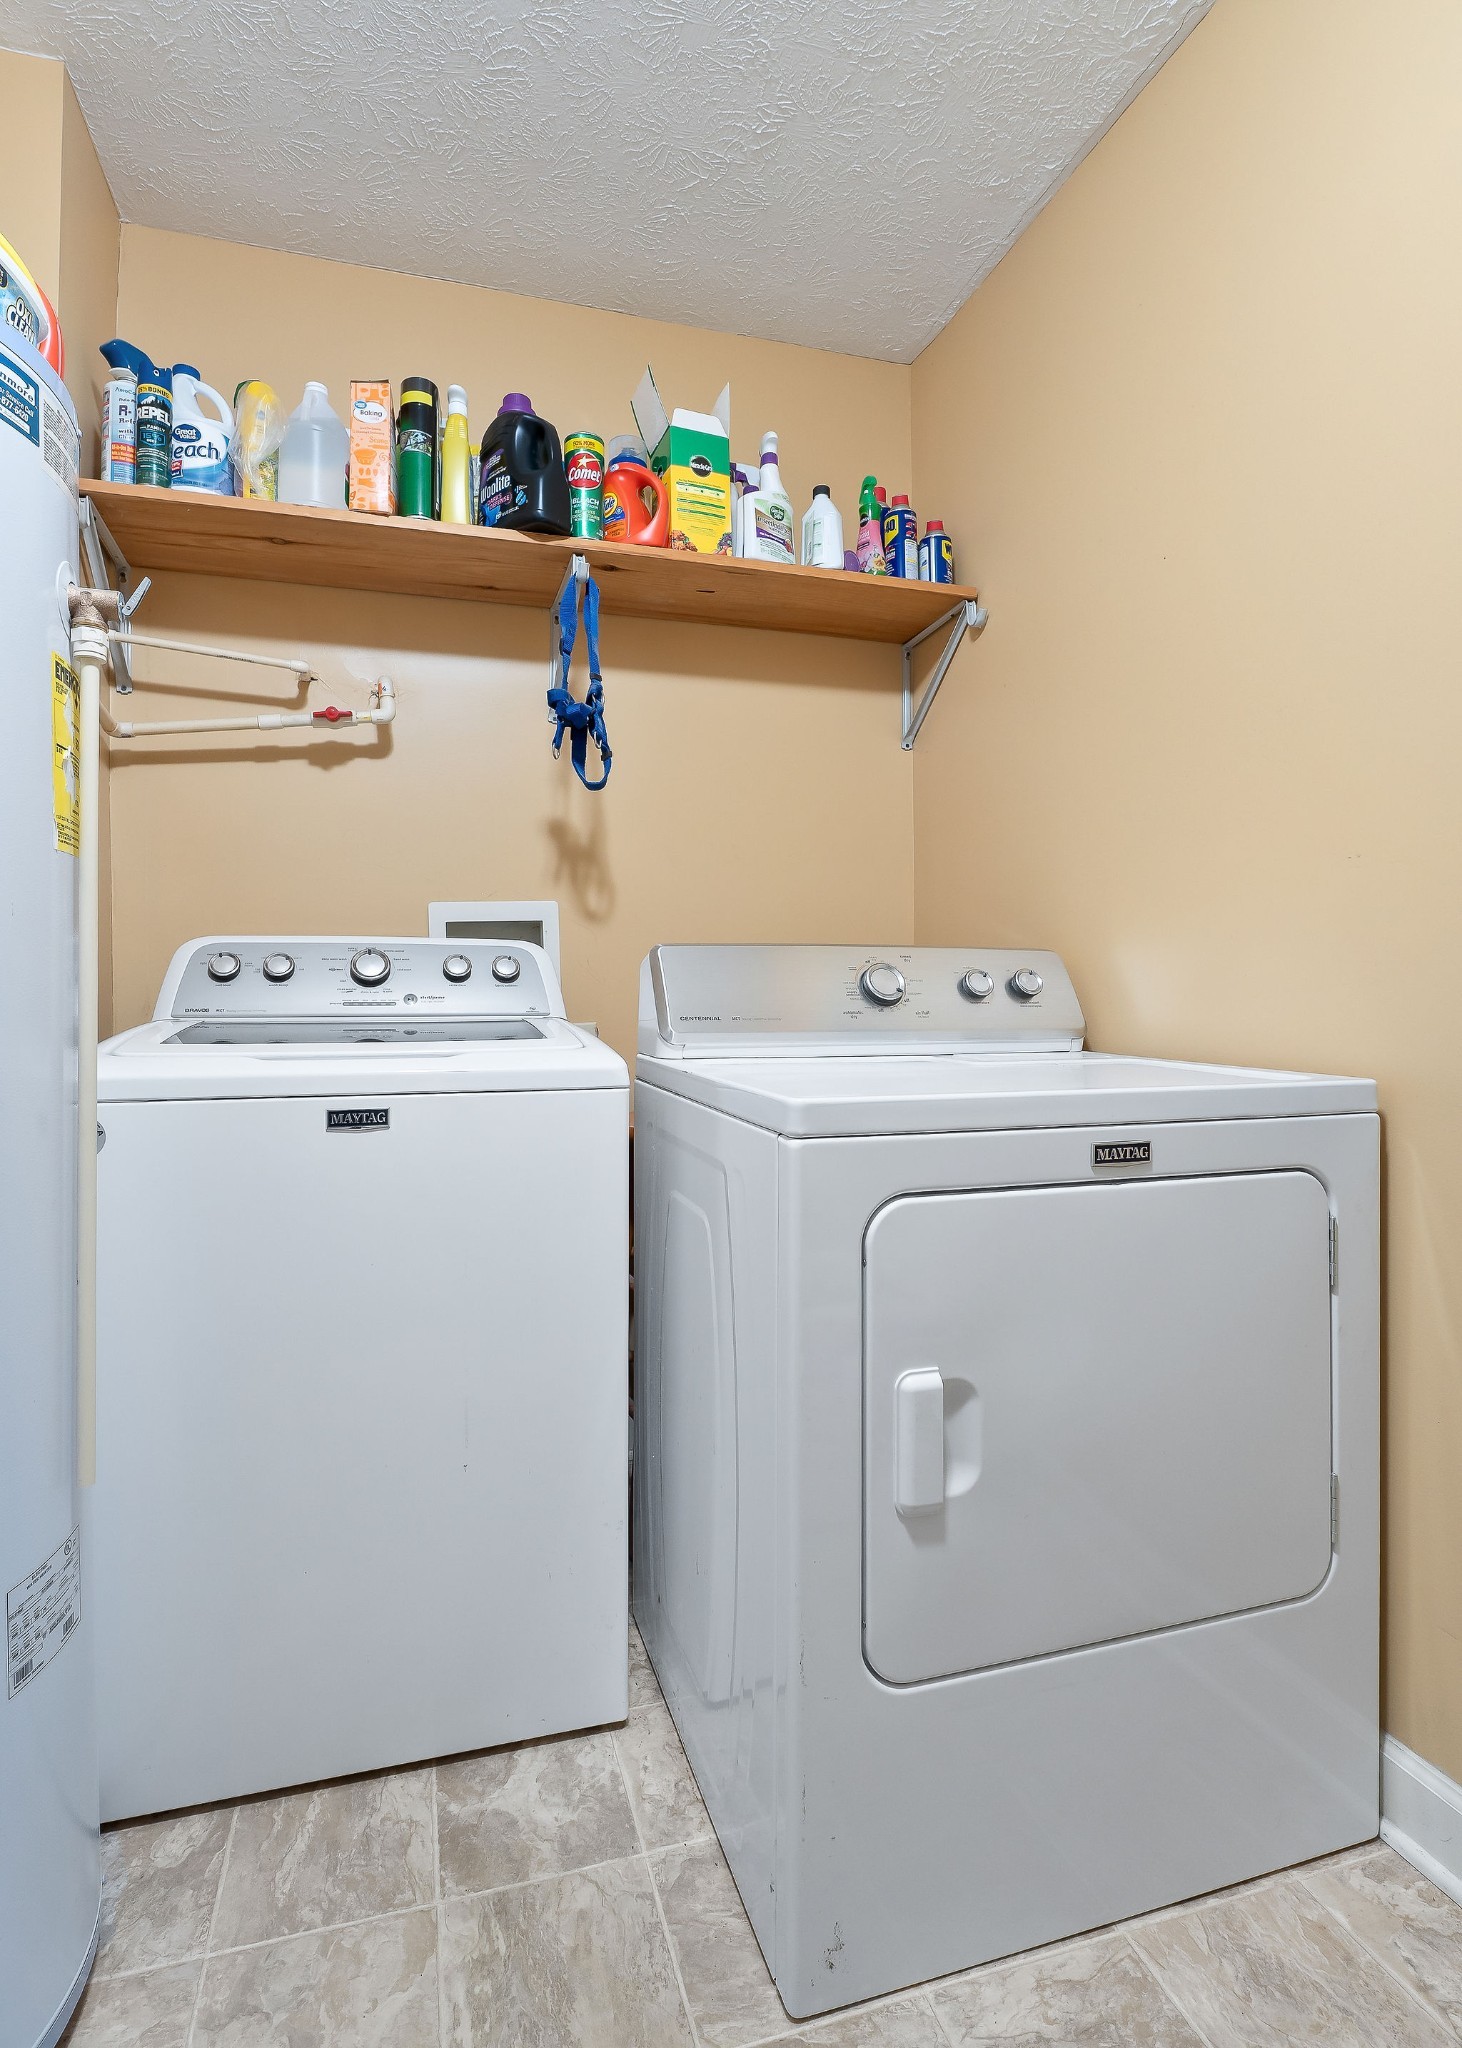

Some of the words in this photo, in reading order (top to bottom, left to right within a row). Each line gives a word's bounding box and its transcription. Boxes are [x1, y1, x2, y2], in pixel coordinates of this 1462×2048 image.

[16, 297, 33, 323] OXI
[0, 371, 34, 403] nmore
[147, 386, 170, 398] BONUS
[360, 409, 383, 418] Baking
[174, 427, 197, 435] Great
[173, 441, 219, 460] each
[568, 466, 601, 483] Comet
[480, 475, 511, 504] Woolite
[572, 497, 600, 506] BLACH
[330, 1112, 386, 1125] MAYTAG
[1096, 1146, 1149, 1161] MAYTAG
